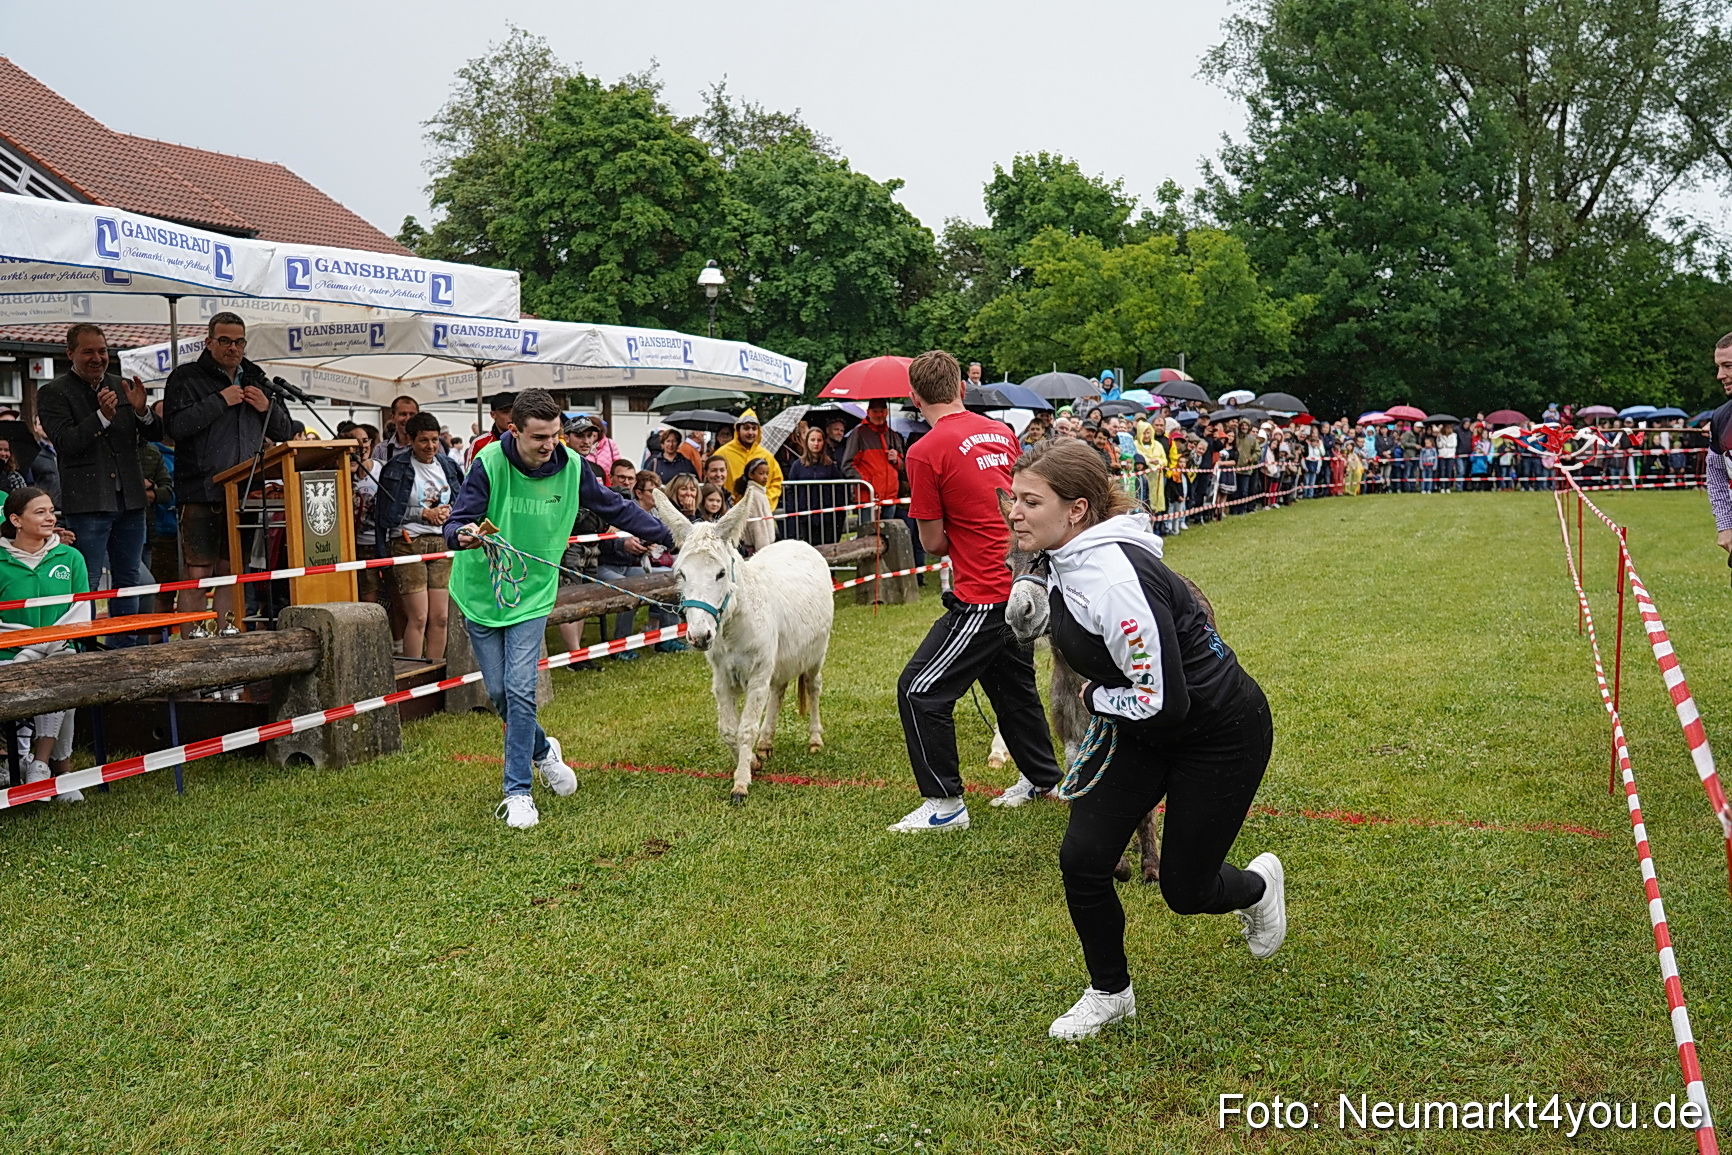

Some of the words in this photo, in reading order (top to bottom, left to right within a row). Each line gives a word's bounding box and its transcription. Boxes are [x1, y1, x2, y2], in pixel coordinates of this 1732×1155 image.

[121, 220, 211, 255] GANSBRÄU
[166, 258, 184, 266] guter
[315, 257, 426, 284] GANSBRÄU
[30, 272, 56, 282] guter
[56, 270, 100, 282] Schluck
[315, 280, 366, 293] Neumarkt's
[368, 288, 390, 296] guter
[389, 287, 427, 301] Schluck
[303, 322, 368, 337] GANSBRÄU
[450, 323, 522, 340] GANSBRÄU
[959, 438, 973, 456] ASV
[969, 433, 1010, 447] NEUMARKT
[315, 541, 331, 554] Stadt
